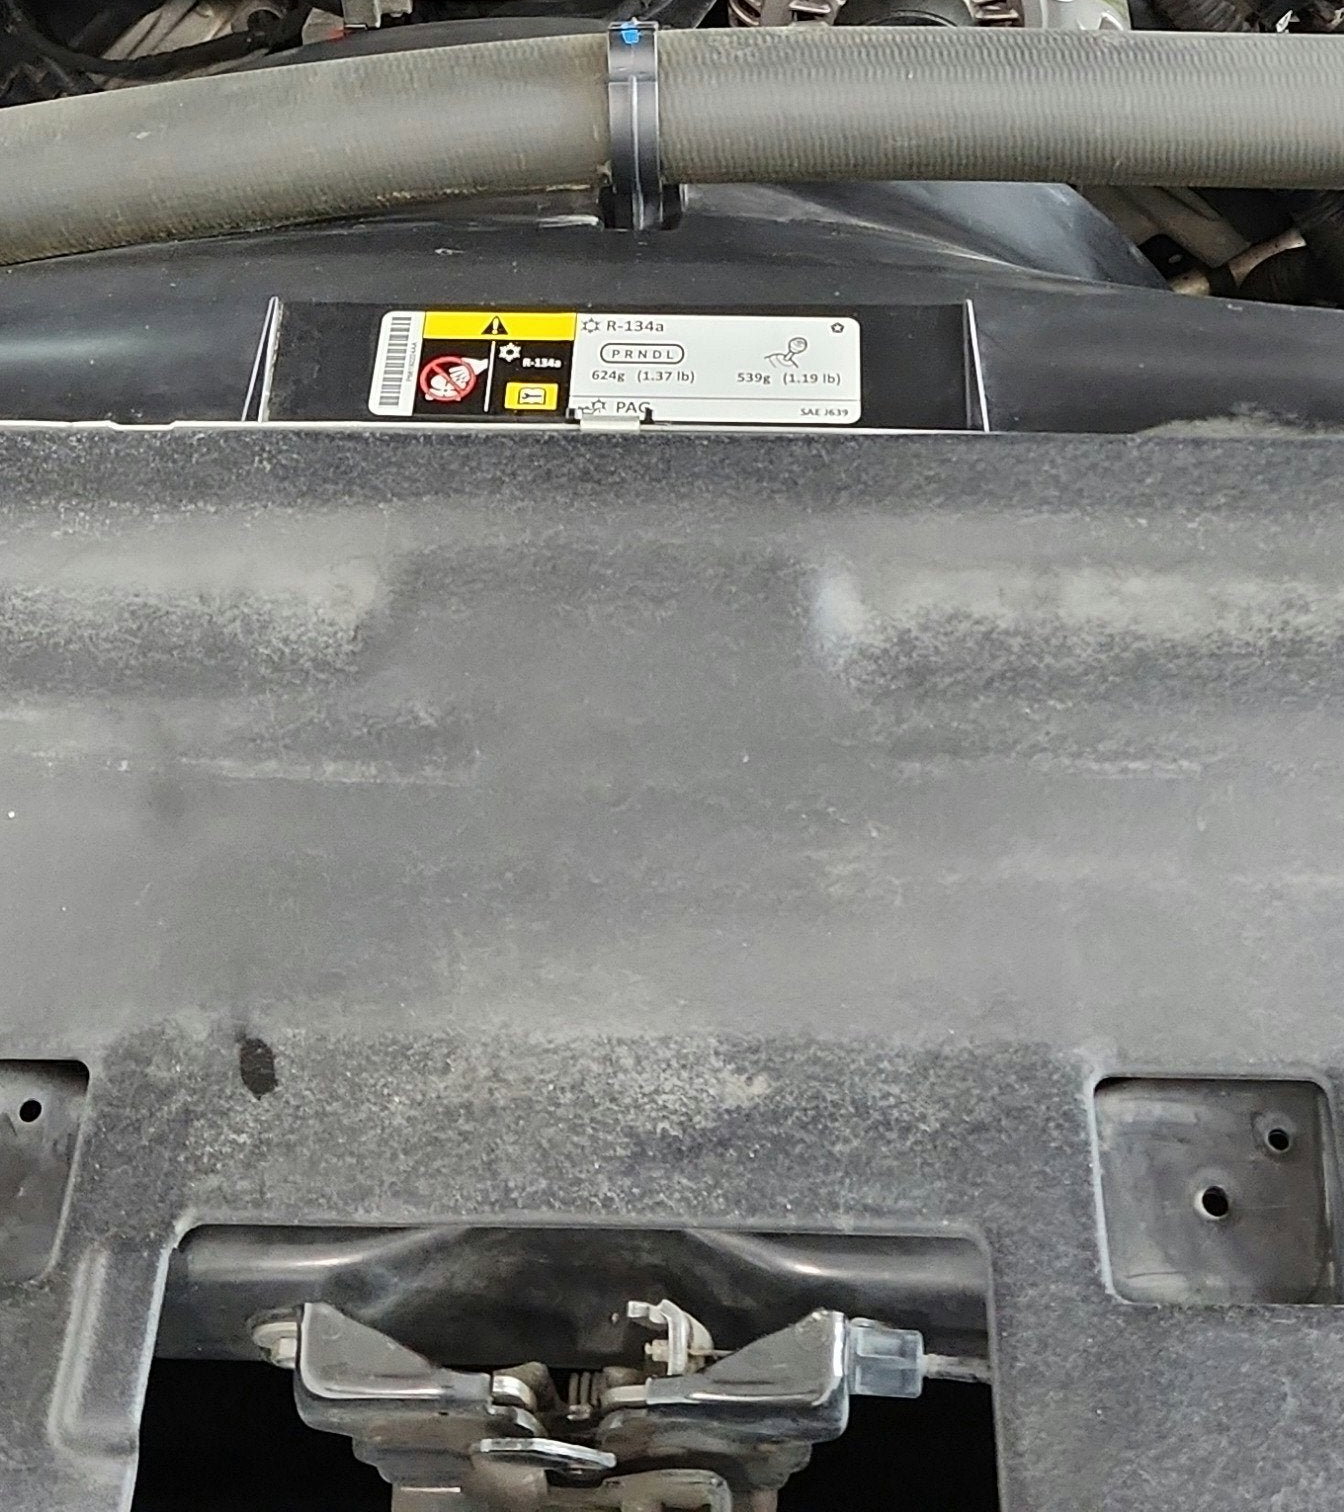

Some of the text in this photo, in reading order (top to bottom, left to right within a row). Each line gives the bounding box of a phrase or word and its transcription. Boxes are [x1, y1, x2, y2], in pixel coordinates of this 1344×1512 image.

[606, 320, 664, 333] R-134a
[592, 370, 695, 384] 624g (1.37 lb)
[737, 372, 841, 386] 539g (1.19 lb)
[800, 408, 821, 417] SAE
